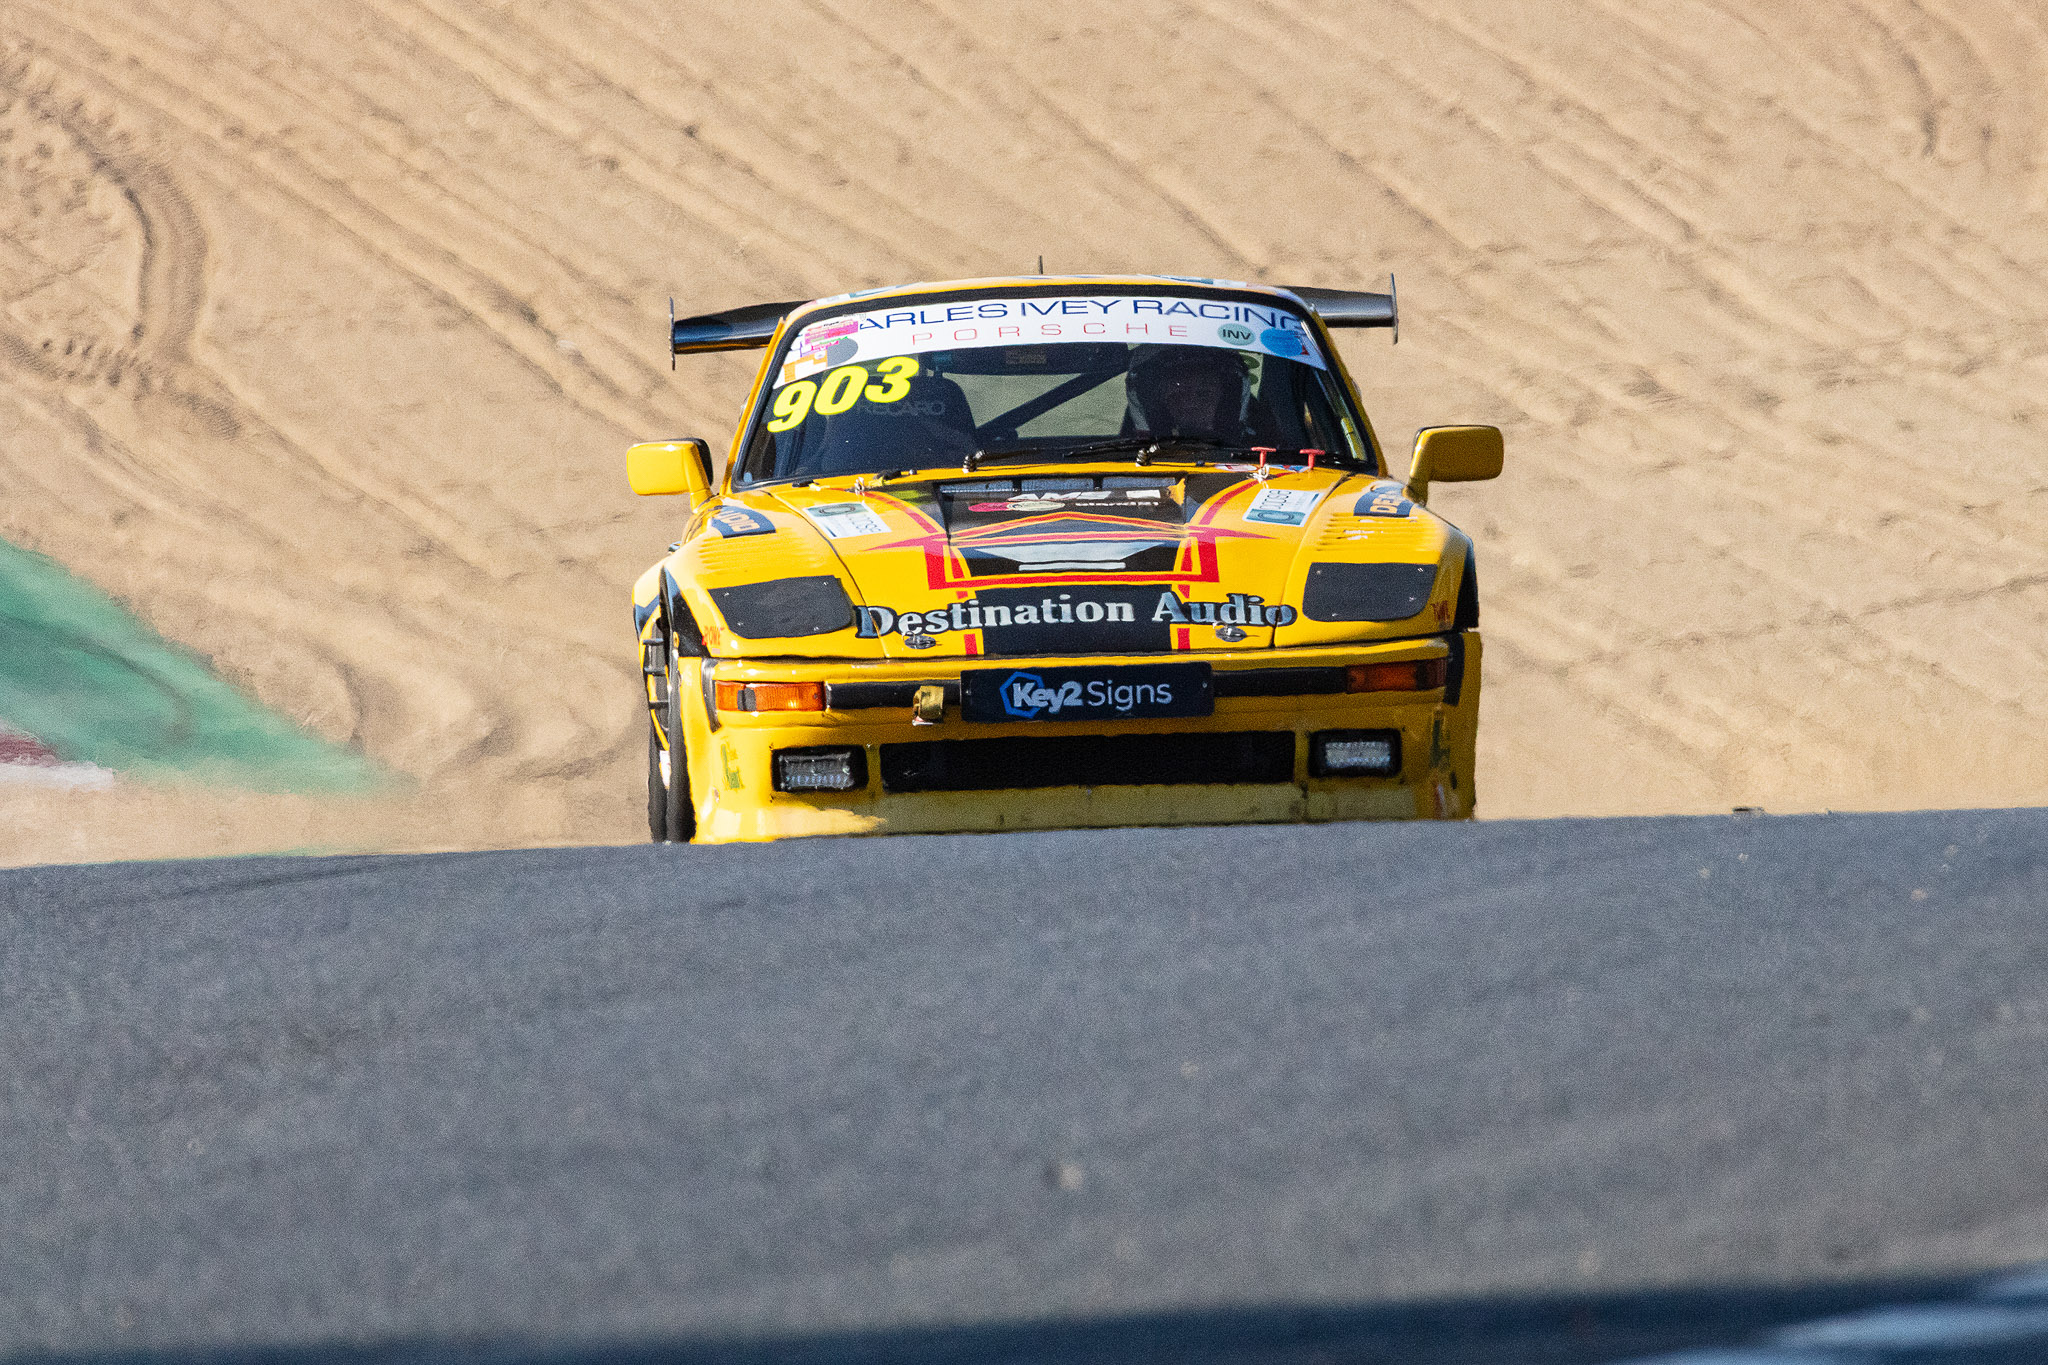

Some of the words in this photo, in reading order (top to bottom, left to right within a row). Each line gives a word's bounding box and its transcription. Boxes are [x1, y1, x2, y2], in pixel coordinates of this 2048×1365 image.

[859, 302, 1008, 330] ARLES
[1020, 299, 1121, 317] IVEY
[912, 321, 1189, 346] PORSCHE
[1222, 328, 1251, 342] INV
[766, 356, 920, 433] 903
[854, 592, 1136, 639] Destination
[1151, 591, 1298, 627] Audio
[1012, 681, 1084, 715] Key2
[1087, 678, 1173, 709] Signs
